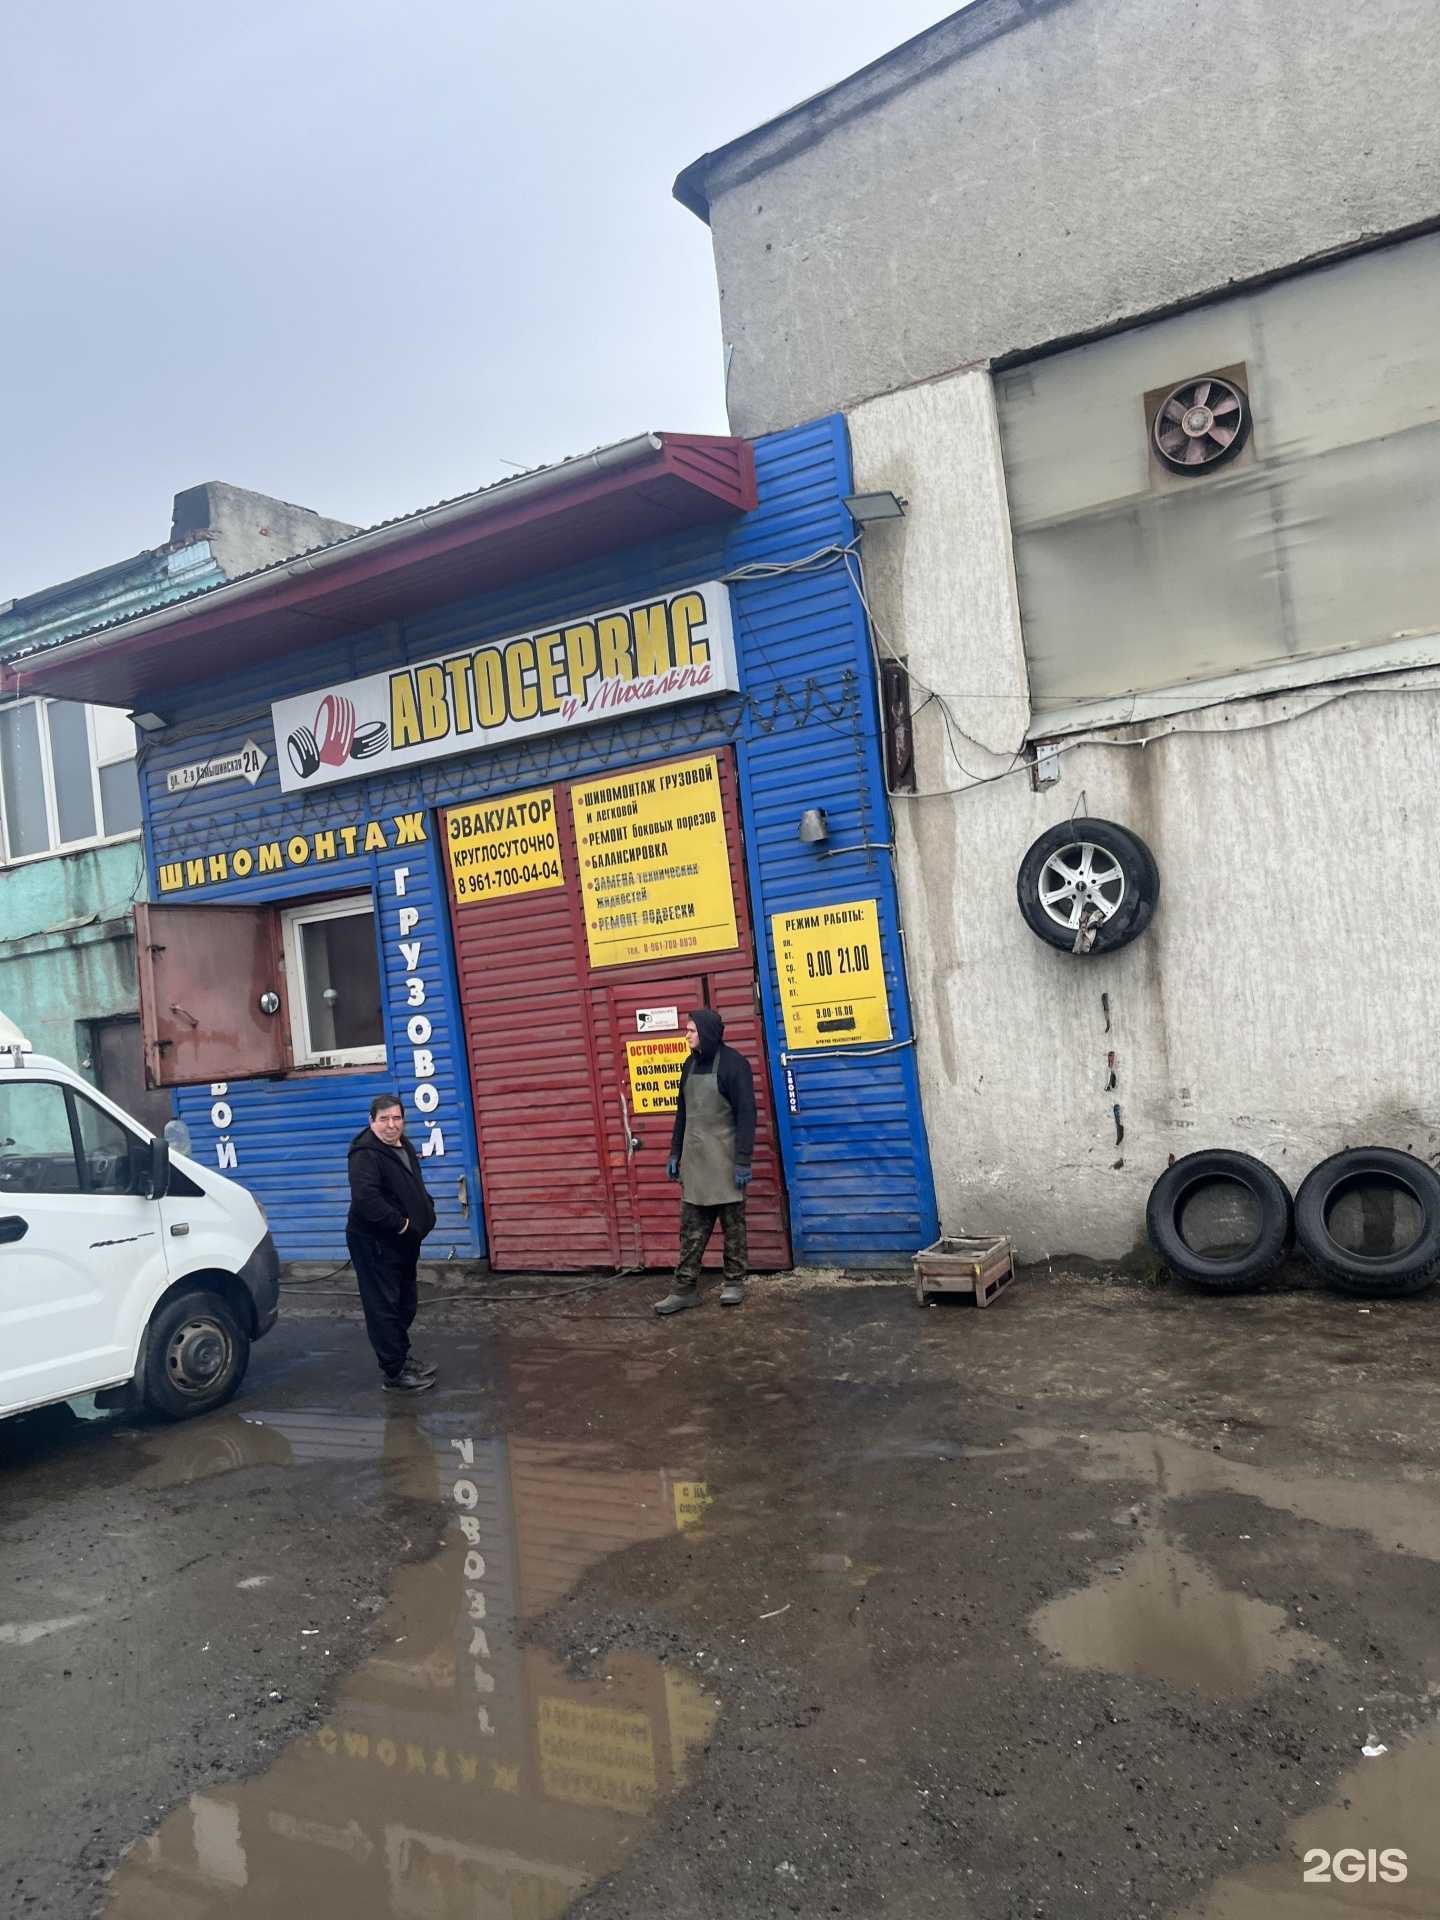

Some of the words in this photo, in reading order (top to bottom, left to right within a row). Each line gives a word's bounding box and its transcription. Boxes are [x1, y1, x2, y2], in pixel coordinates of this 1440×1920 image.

[389, 591, 711, 751] АВТОСЕРВИС
[560, 696, 578, 722] у
[588, 663, 714, 713] Михалыча
[243, 750, 260, 773] 2А
[584, 779, 656, 807] ШИНОМОНТАЖ
[660, 764, 713, 790] ГРУЗОВОЙ
[450, 799, 552, 840] ЭВАКУАТОР
[586, 812, 593, 824] и
[596, 801, 638, 823] легковой
[588, 826, 628, 846] РЕМОНТ
[632, 820, 673, 838] боковых
[677, 811, 717, 831] порезов
[158, 811, 429, 892] ШИНОМОНТАЖ
[453, 833, 555, 867] КРУГЛОСУТОЧНО
[591, 843, 668, 869] БАЛАНСИРОВКА
[458, 877, 466, 894] 8
[469, 860, 559, 892] 961-700-04-04
[594, 871, 636, 891] ЗАМЕНА
[598, 911, 638, 931] РЕМОНТ
[642, 903, 695, 925] ПОДВЕСКИ
[785, 915, 820, 932] РЕЖИМ
[823, 909, 864, 926] РАБОТЫ:
[806, 949, 833, 978] 9.00
[838, 944, 869, 974] 21.00
[394, 867, 445, 1157] ГРУЗОВОЙ
[630, 1041, 687, 1056] ОСТОРОЖНО!
[635, 1081, 659, 1092] СХОД
[786, 1070, 797, 1112] ЗВОНОК
